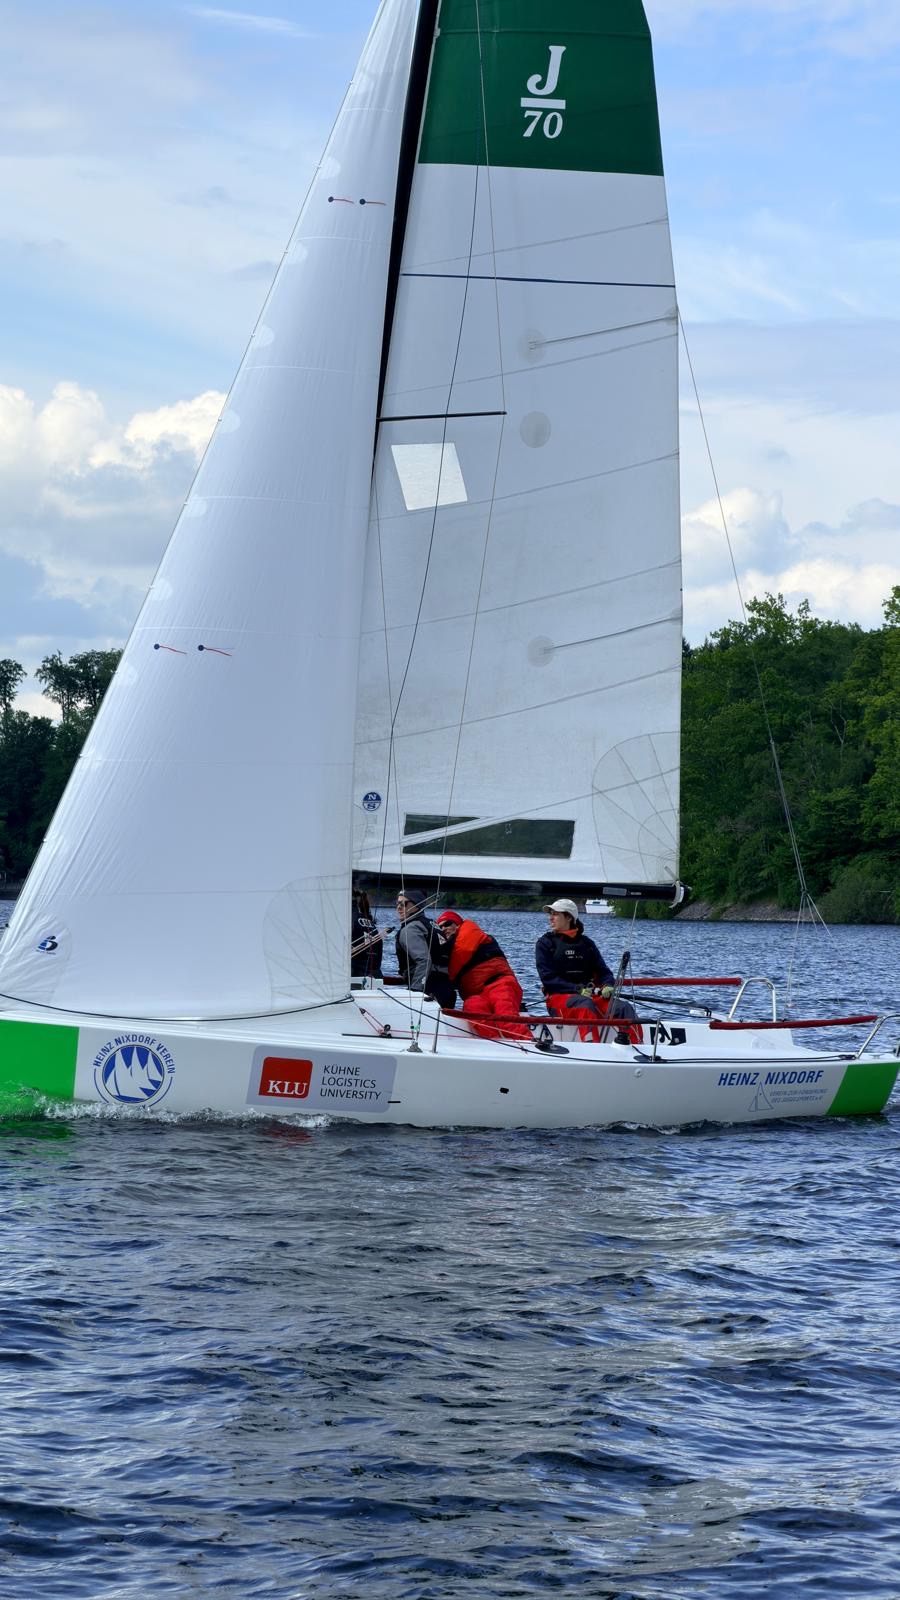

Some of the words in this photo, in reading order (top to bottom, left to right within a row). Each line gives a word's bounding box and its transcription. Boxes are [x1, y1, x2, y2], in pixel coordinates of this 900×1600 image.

[527, 45, 566, 95] J
[523, 110, 563, 138] 70
[93, 1042, 114, 1067] HEINZ
[114, 1034, 156, 1046] NIXDORF
[156, 1043, 175, 1074] VEREIN
[323, 1064, 361, 1076] KÜHNE
[718, 1072, 760, 1086] HEINZ
[765, 1070, 824, 1084] NIXDORF
[267, 1079, 308, 1096] KLU
[321, 1076, 376, 1089] LOGISTICS
[320, 1088, 381, 1100] UNIVERSITY
